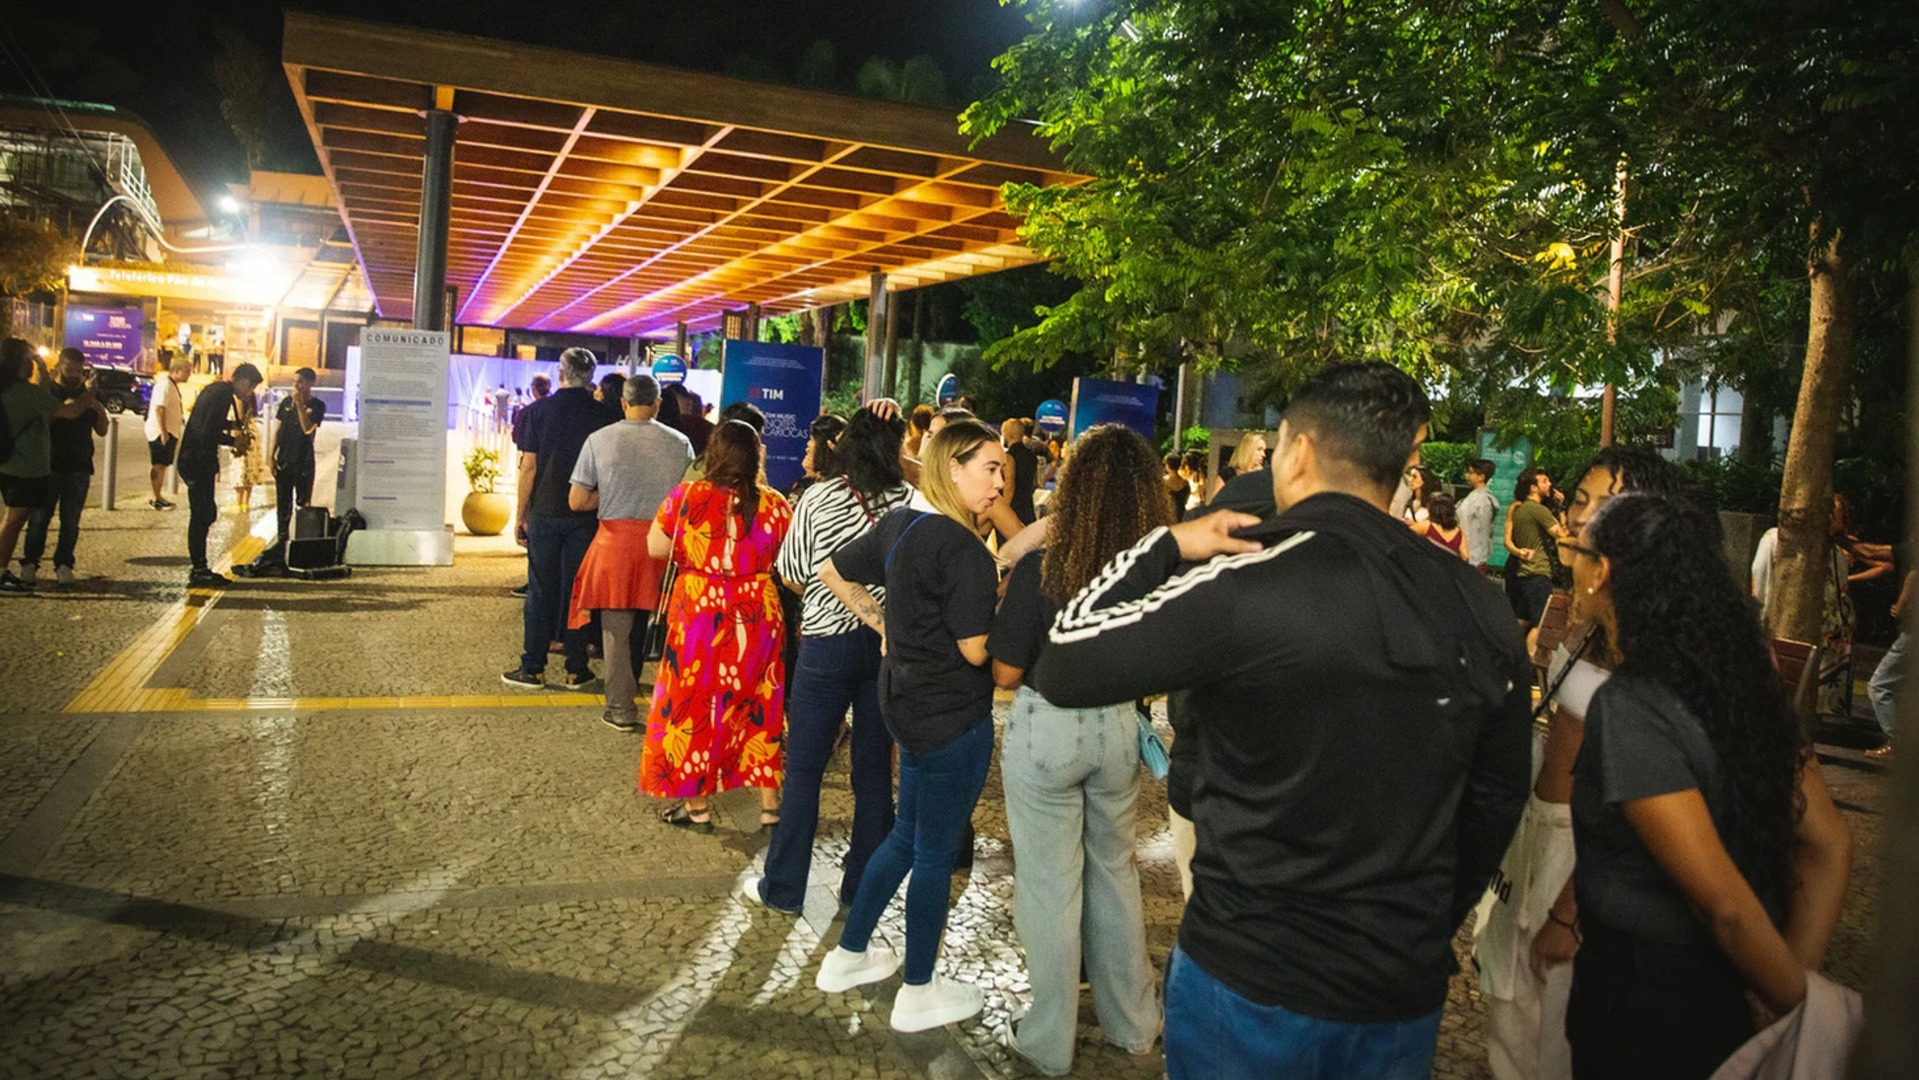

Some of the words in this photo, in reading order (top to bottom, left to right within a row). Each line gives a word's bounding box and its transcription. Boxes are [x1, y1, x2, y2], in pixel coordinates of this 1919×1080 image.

[366, 333, 445, 346] COMUNICADO
[761, 388, 783, 400] TIM
[762, 426, 809, 440] CARIOCAS
